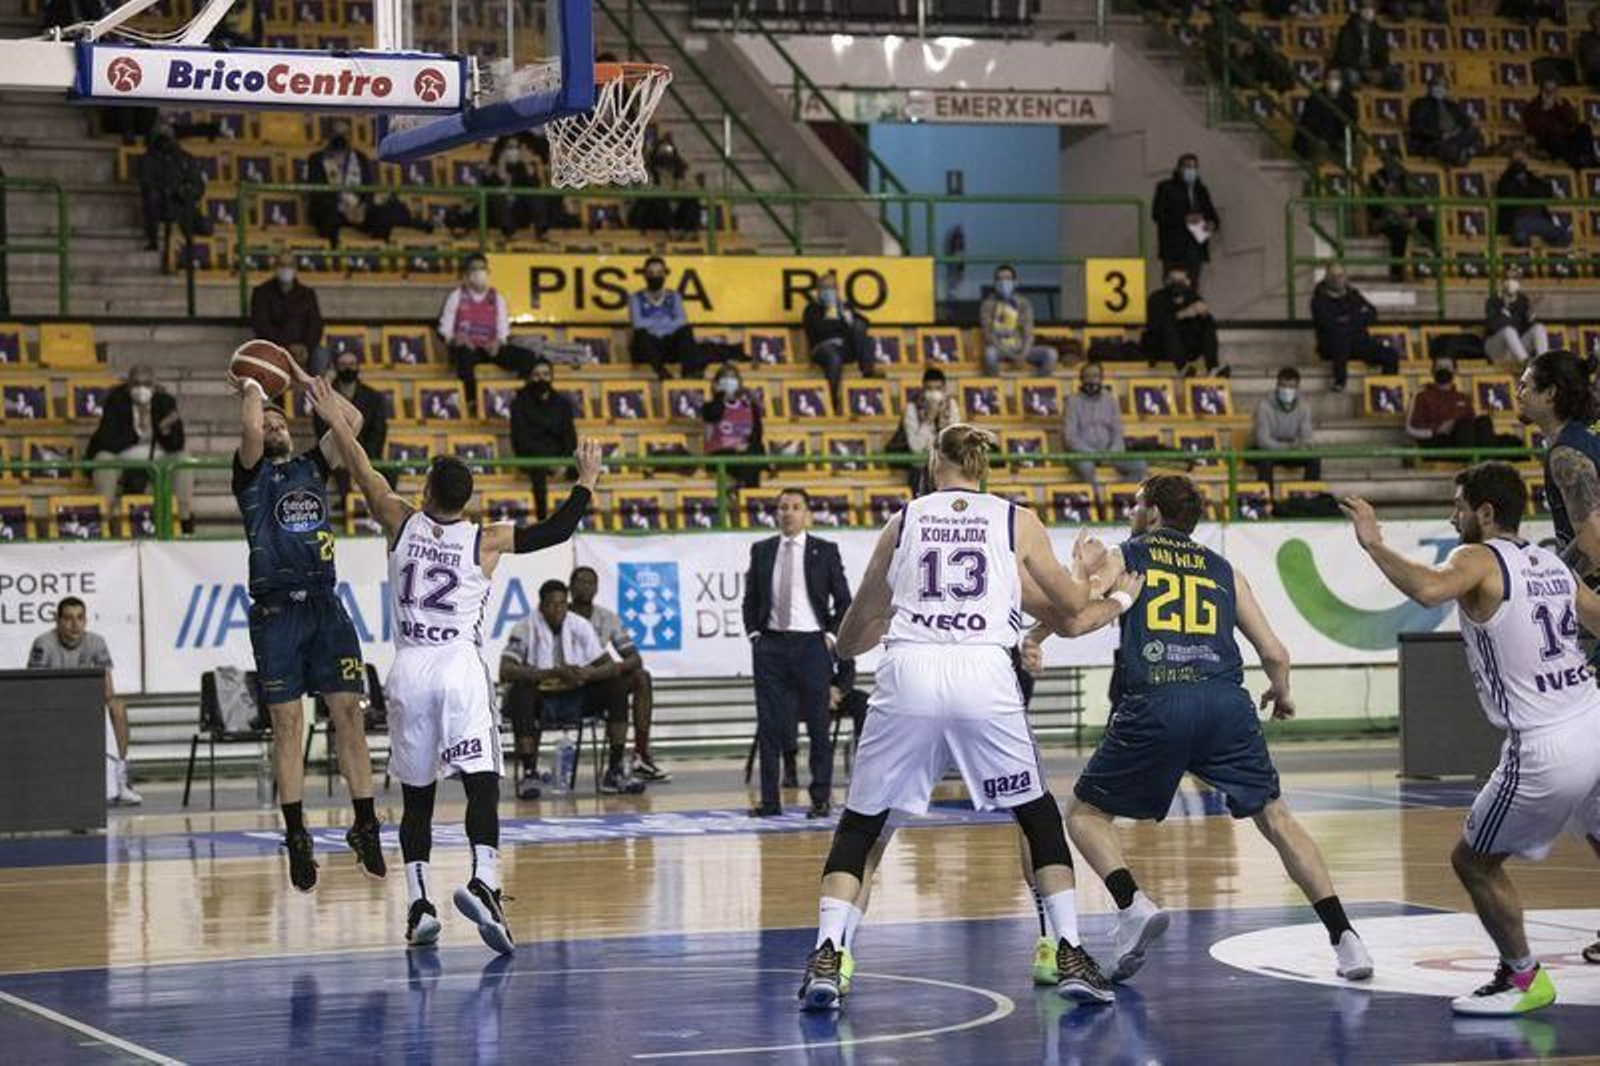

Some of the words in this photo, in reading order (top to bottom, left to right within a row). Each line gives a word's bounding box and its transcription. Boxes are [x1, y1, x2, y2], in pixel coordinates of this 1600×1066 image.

[167, 59, 392, 98] BricoCentro
[935, 96, 1095, 119] EMERXENCIA
[529, 266, 713, 312] PISA
[782, 267, 888, 311] RO
[1104, 271, 1129, 313] 3
[921, 527, 986, 543] KOHAJDA
[407, 543, 462, 567] TIMMER
[400, 560, 461, 615] 12
[918, 548, 988, 602] 13
[1146, 569, 1217, 634] 26
[697, 609, 741, 638] DE
[441, 737, 483, 763] gaza
[983, 770, 1032, 799] gaza
